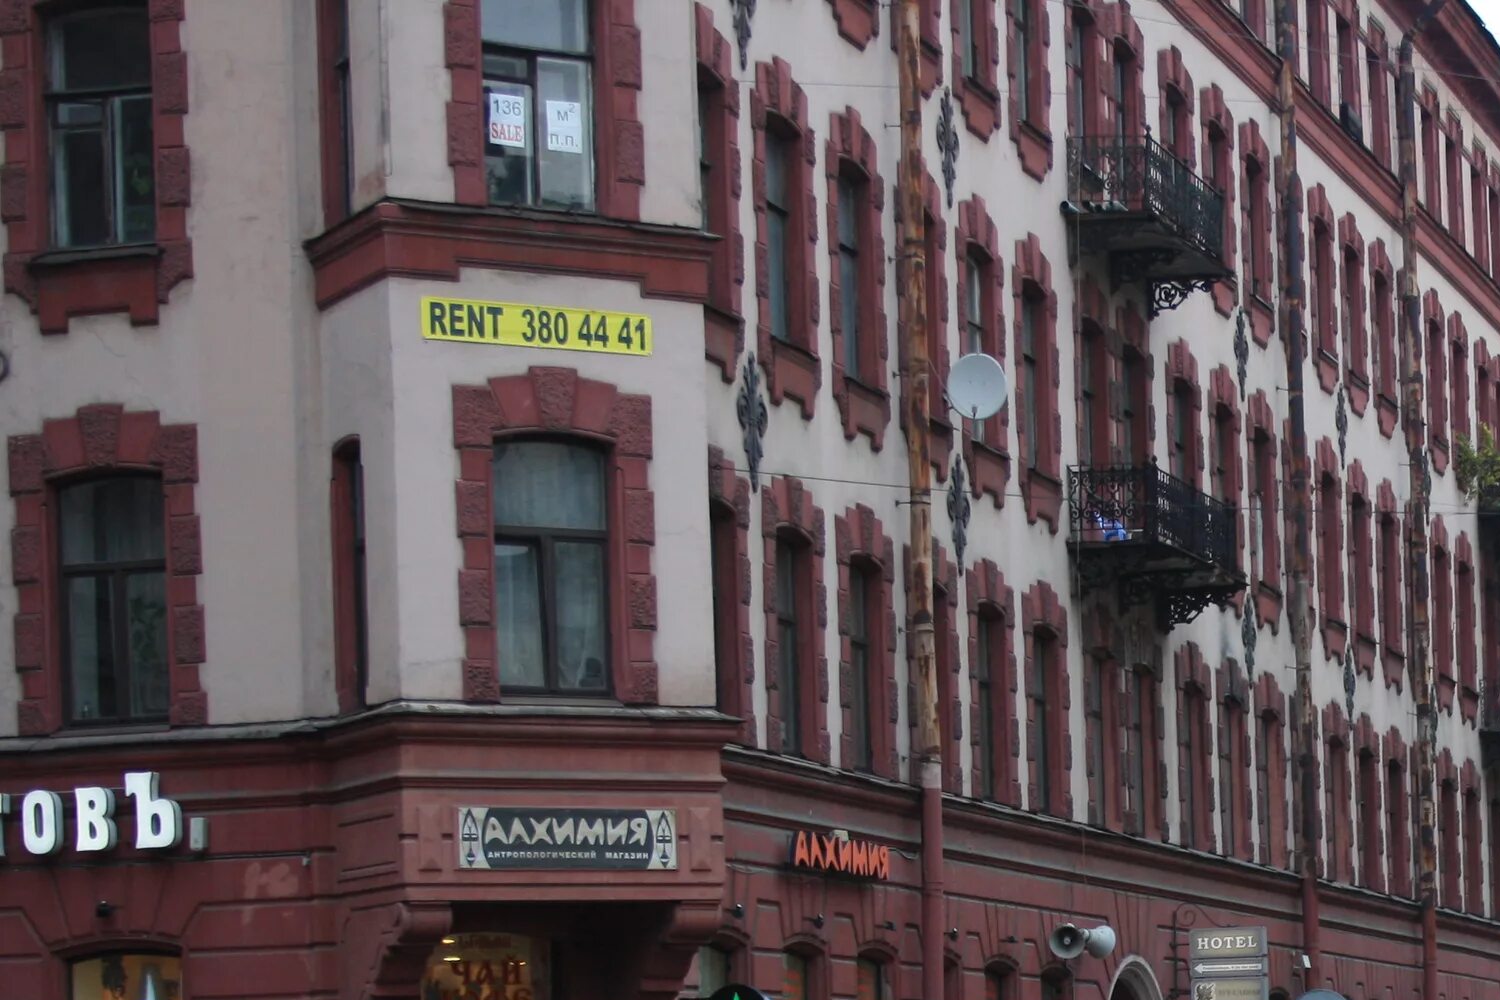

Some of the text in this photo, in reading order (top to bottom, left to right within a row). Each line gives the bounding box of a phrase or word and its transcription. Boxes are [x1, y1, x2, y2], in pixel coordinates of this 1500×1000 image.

[493, 99, 522, 116] 136
[491, 122, 523, 142] SALE
[429, 301, 647, 350] RENT 380 44 41
[484, 817, 649, 846] АЛХИМИЯ
[487, 851, 649, 860] АНТРОПОЛОГИЧЕСКИЙ МАГАЗИН
[794, 830, 889, 881] АЛХИМИЯ
[1197, 935, 1258, 949] HOTEL
[450, 954, 522, 986] ЧАЙ
